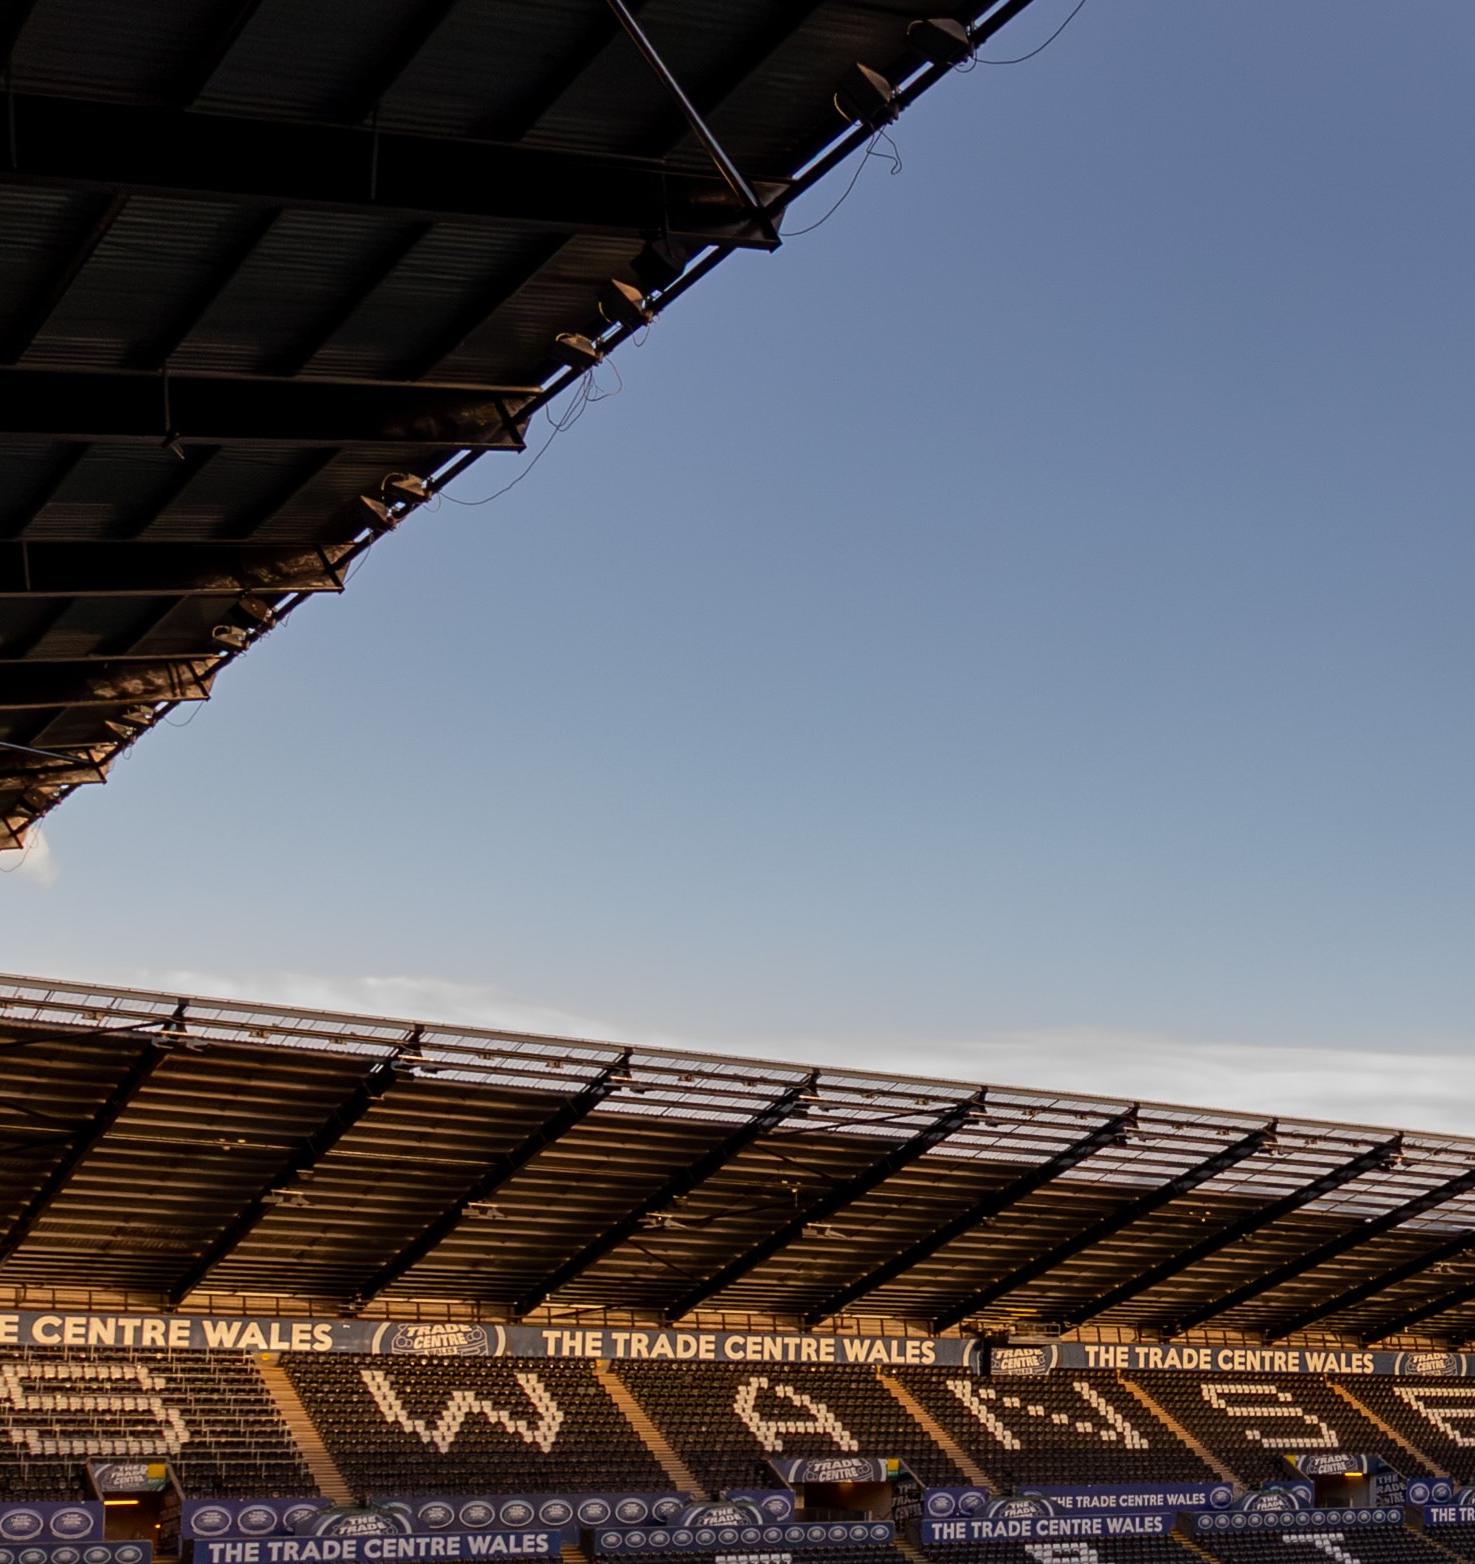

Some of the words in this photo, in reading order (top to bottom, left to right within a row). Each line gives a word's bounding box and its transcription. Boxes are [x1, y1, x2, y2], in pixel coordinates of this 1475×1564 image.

[32, 1316, 190, 1347] CENTRE
[202, 1319, 333, 1352] WALES
[413, 1332, 467, 1347] CENTRE
[542, 1330, 603, 1357] THE
[611, 1332, 716, 1360] TRADE
[724, 1335, 835, 1363] CENTRE
[842, 1338, 936, 1365] WALES
[1001, 1357, 1041, 1369] CENTRE
[1085, 1345, 1129, 1368] THE
[1134, 1347, 1212, 1371] TRADE
[1218, 1349, 1300, 1373] CENTRE
[1305, 1352, 1374, 1375] WALES
[813, 1459, 864, 1472] TRADE
[1312, 1455, 1350, 1466] TRADE
[818, 1468, 860, 1480] CENTRE
[1318, 1463, 1348, 1474] CENTRE
[1075, 1495, 1117, 1508] TRADE
[1119, 1494, 1164, 1507] CENTRE
[1166, 1493, 1206, 1505] WALES
[711, 1507, 734, 1517] THE
[1430, 1507, 1456, 1522] THE
[348, 1515, 375, 1525] THE
[703, 1514, 743, 1525] TRADE
[339, 1523, 387, 1534] TRADE
[931, 1522, 967, 1540] THE
[970, 1520, 1032, 1539] TRADE
[1036, 1518, 1103, 1537] CENTRE
[1106, 1516, 1164, 1534] WALES
[208, 1541, 261, 1564] THE
[267, 1538, 357, 1562] TRADE
[363, 1536, 461, 1559] CENTRE
[467, 1533, 550, 1555] WALES
